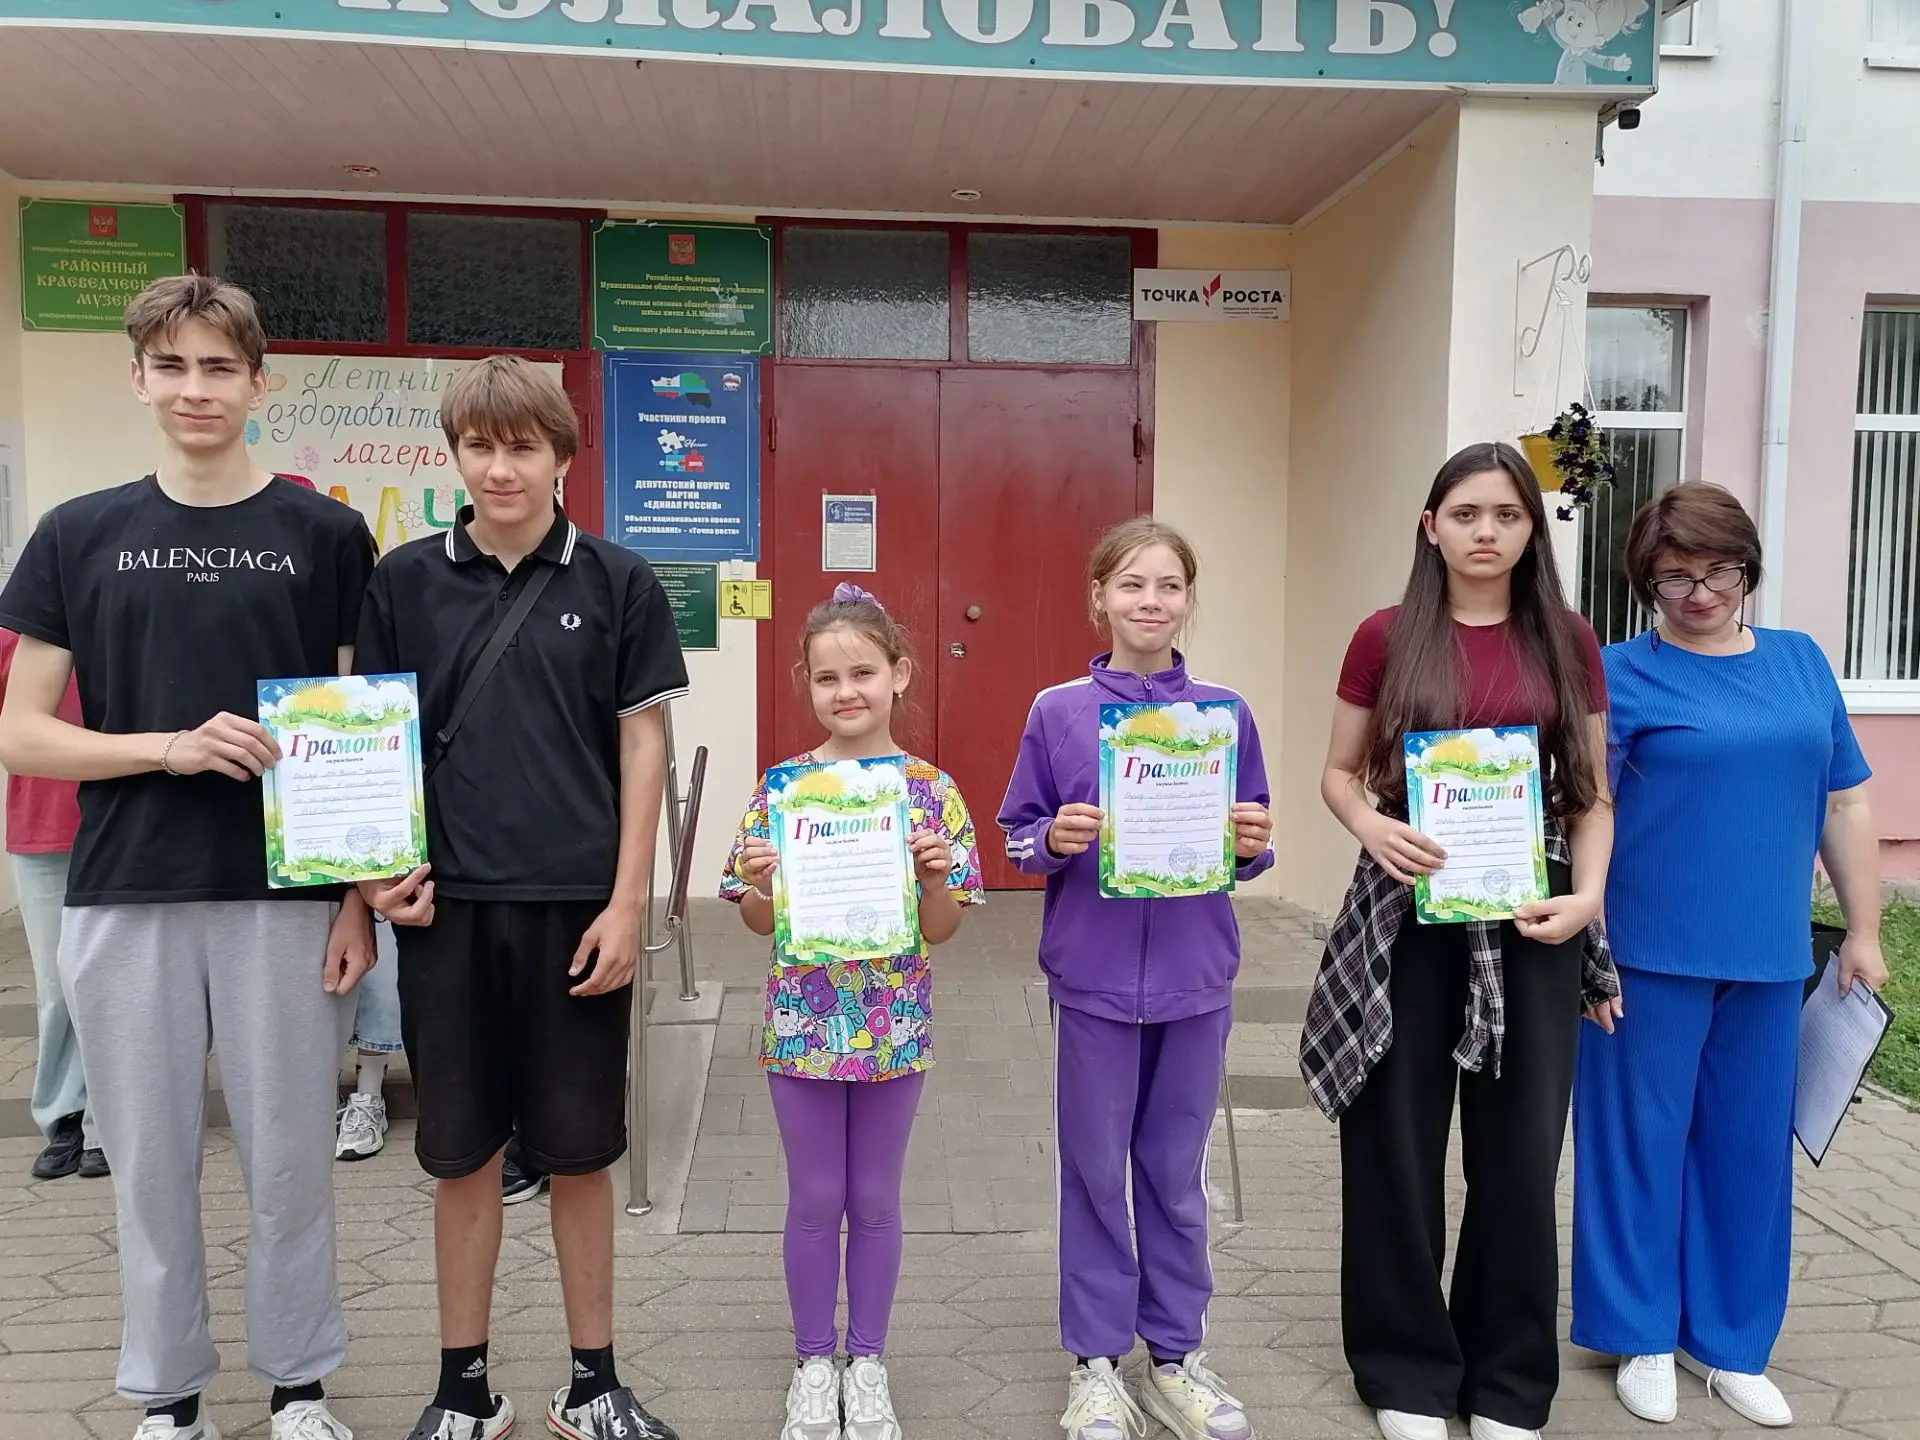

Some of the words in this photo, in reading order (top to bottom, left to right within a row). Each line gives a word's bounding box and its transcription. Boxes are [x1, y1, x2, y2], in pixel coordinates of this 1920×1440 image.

[1141, 288, 1199, 303] ТОЧКА
[1223, 290, 1282, 304] РОСТА
[638, 412, 687, 424] Участники
[689, 415, 726, 425] проекта
[333, 443, 448, 477] лагерь
[635, 480, 696, 490] ДЕПУТАТСКИЙ
[697, 482, 730, 490] КОРПУС
[666, 491, 700, 499] ПАРТИИ
[117, 547, 296, 575] BALENCIAGA
[187, 572, 220, 583] PARIS
[289, 733, 400, 763] Грамота
[1124, 756, 1220, 784] Грамота
[1432, 783, 1523, 809] Грамота
[794, 816, 892, 845] Грамота
